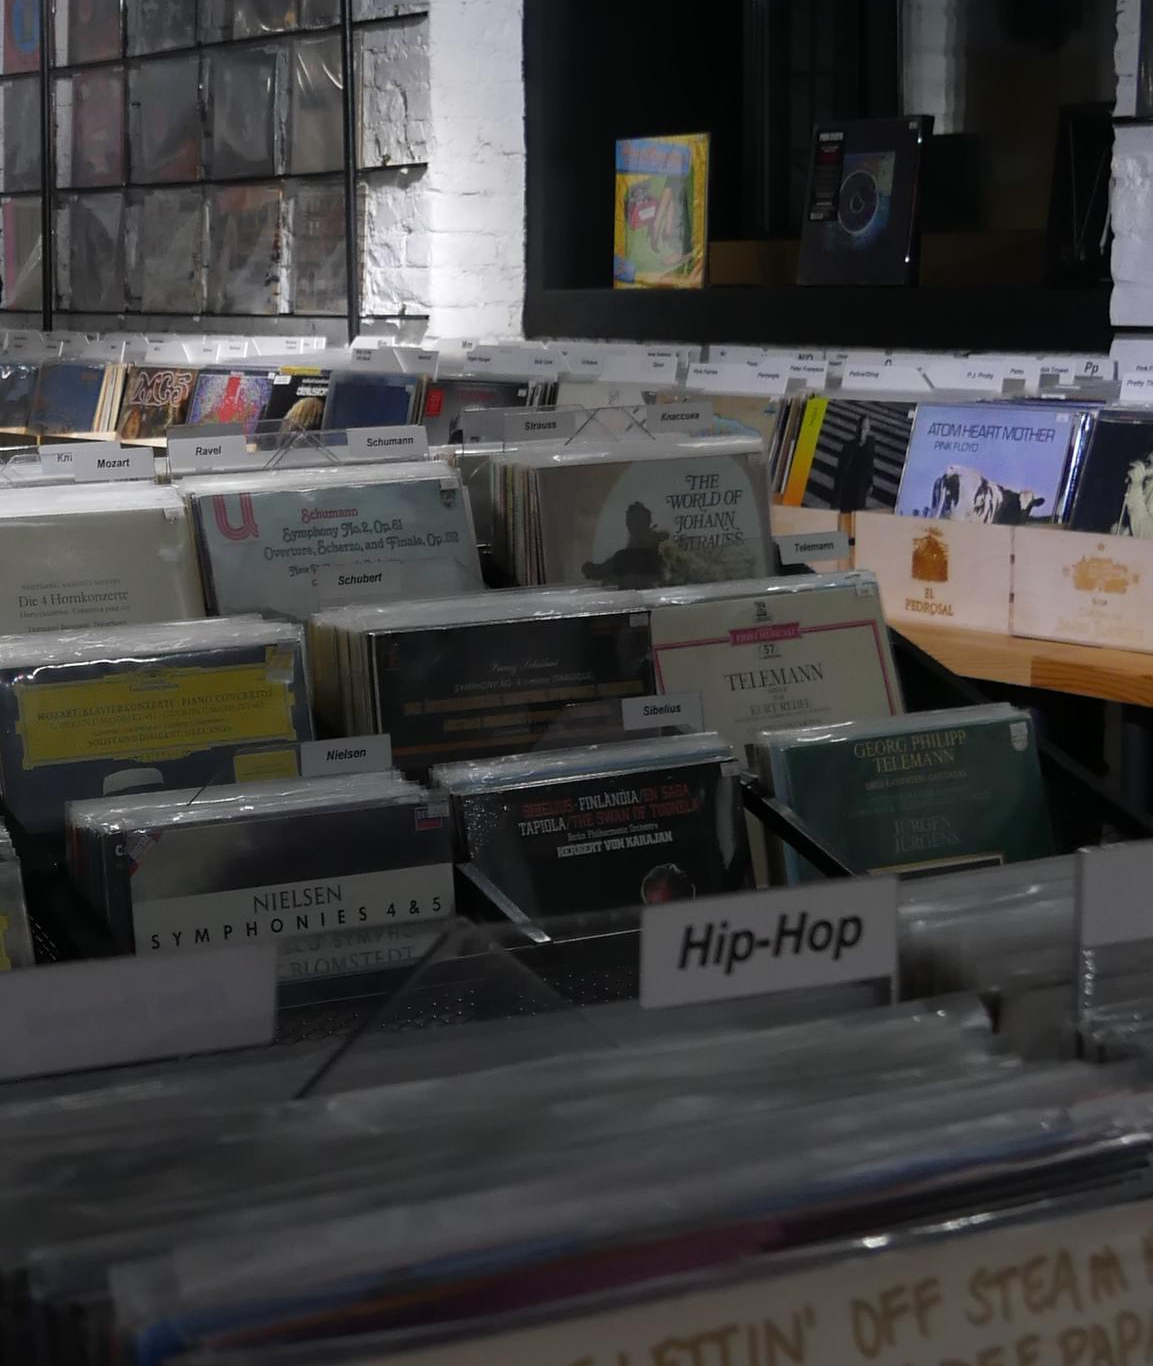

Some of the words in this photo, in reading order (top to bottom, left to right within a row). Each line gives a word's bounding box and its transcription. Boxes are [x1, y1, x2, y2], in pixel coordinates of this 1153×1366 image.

[1084, 362, 1099, 376] Pp
[524, 420, 557, 430] Strauss
[928, 421, 962, 437] ATOM
[963, 423, 1001, 439] HEART
[1001, 426, 1056, 443] MOTHER
[195, 445, 222, 456] Ravel
[366, 435, 414, 447] Schumann
[934, 440, 952, 451] PINK
[953, 442, 979, 453] FLOYD
[97, 458, 130, 468] Mozart
[665, 492, 719, 510] WORLD
[723, 489, 743, 505] OF
[301, 508, 359, 523] Schumann
[673, 509, 736, 533] JOHANN
[282, 526, 339, 543] Symphony
[674, 530, 745, 552] STRAUSS
[264, 546, 317, 561] Overture,
[317, 540, 364, 556] Scherzo,
[364, 537, 384, 550] and
[386, 536, 426, 551] Finale,
[794, 540, 834, 553] Telemann
[337, 572, 383, 586] Schubert
[18, 595, 39, 608] Die
[50, 590, 129, 606] Hornkonzerte
[724, 663, 824, 691] TELEMANN
[643, 701, 682, 717] Sibelius
[326, 747, 366, 761] Nielsen
[854, 738, 908, 759] GEORG
[911, 730, 967, 751] PHILIPP
[871, 749, 955, 773] TELEMANN
[557, 840, 603, 858] HERBERT
[604, 837, 625, 852] VON
[626, 830, 673, 848] KARAJAN
[253, 883, 343, 914] NIELSEN
[151, 904, 368, 950] SYMPHONIES
[386, 903, 397, 917] 4
[409, 899, 421, 914] &
[432, 896, 442, 911] 5
[677, 910, 864, 976] Hip-Hop
[849, 1275, 944, 1360] OFF
[965, 1243, 1132, 1329] STEAM
